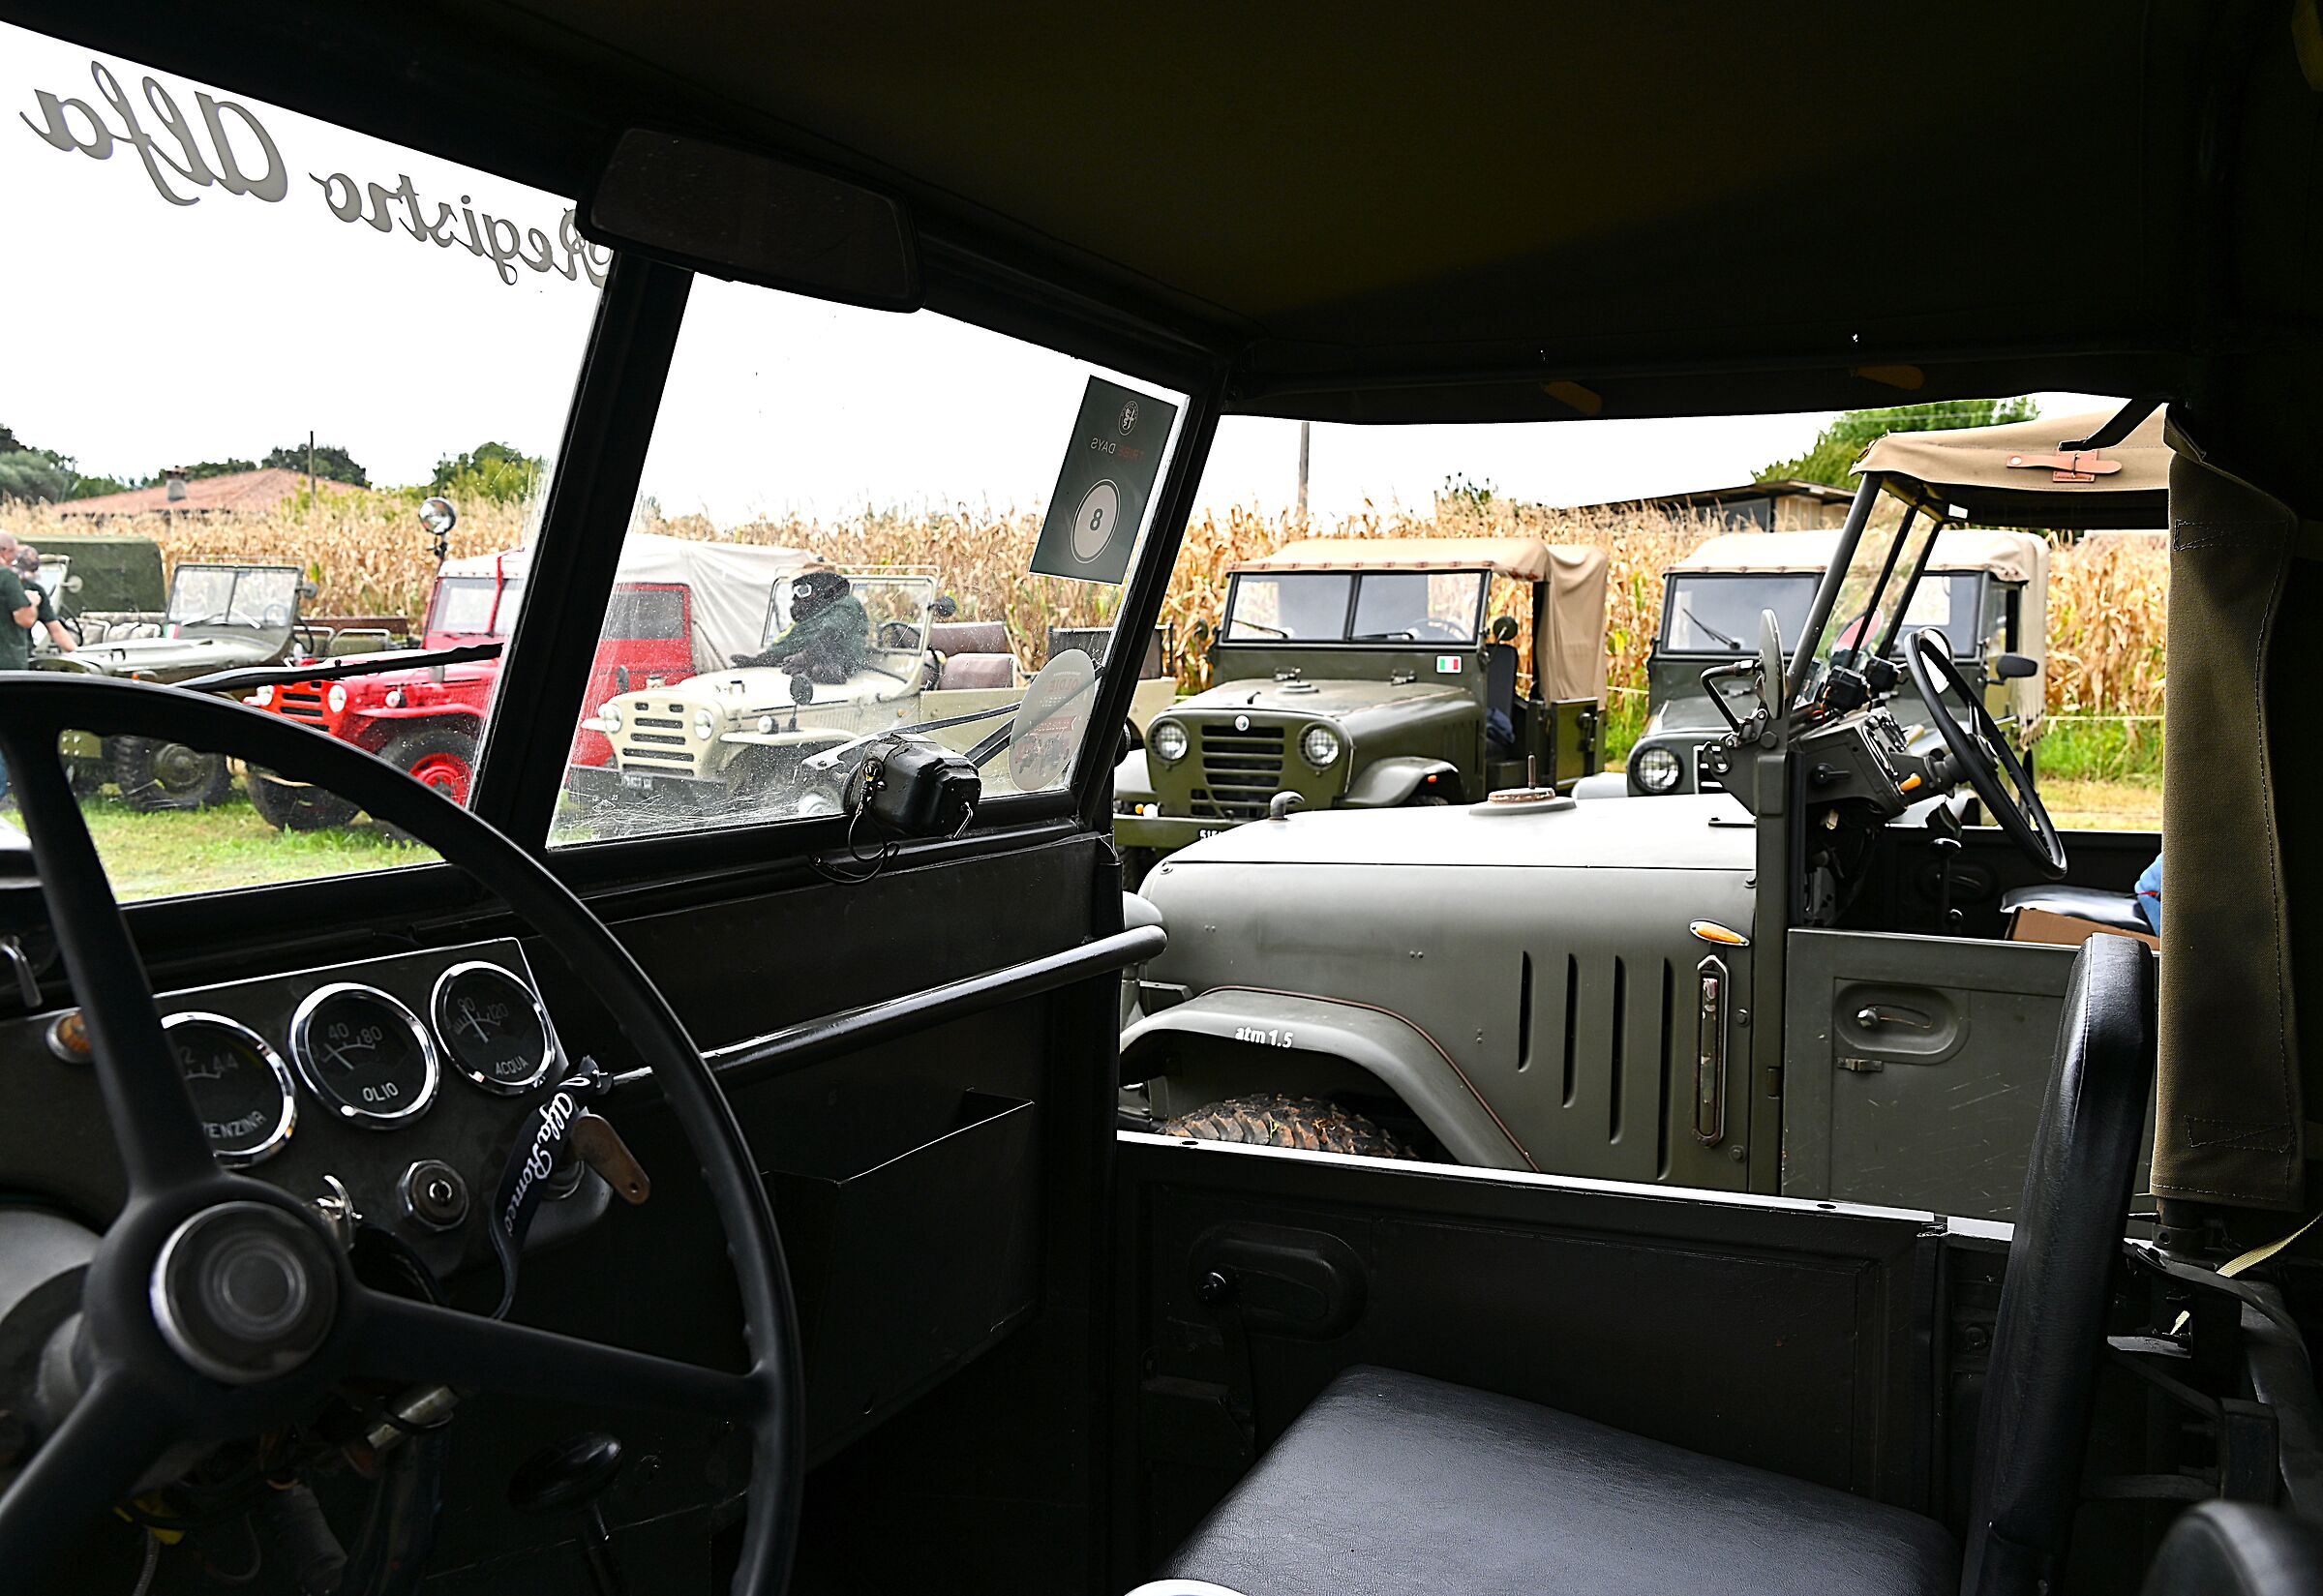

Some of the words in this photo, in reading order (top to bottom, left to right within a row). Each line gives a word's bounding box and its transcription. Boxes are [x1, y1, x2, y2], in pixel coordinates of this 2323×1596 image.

[327, 1022, 349, 1040] 40
[360, 1025, 383, 1044] 80
[1234, 1027, 1266, 1044] atm
[1268, 1029, 1294, 1048] 1.5
[496, 1055, 529, 1075] ACQUA
[362, 1081, 400, 1102] OLIO
[537, 1092, 573, 1145] Alfa
[503, 1142, 554, 1237] Romeo
